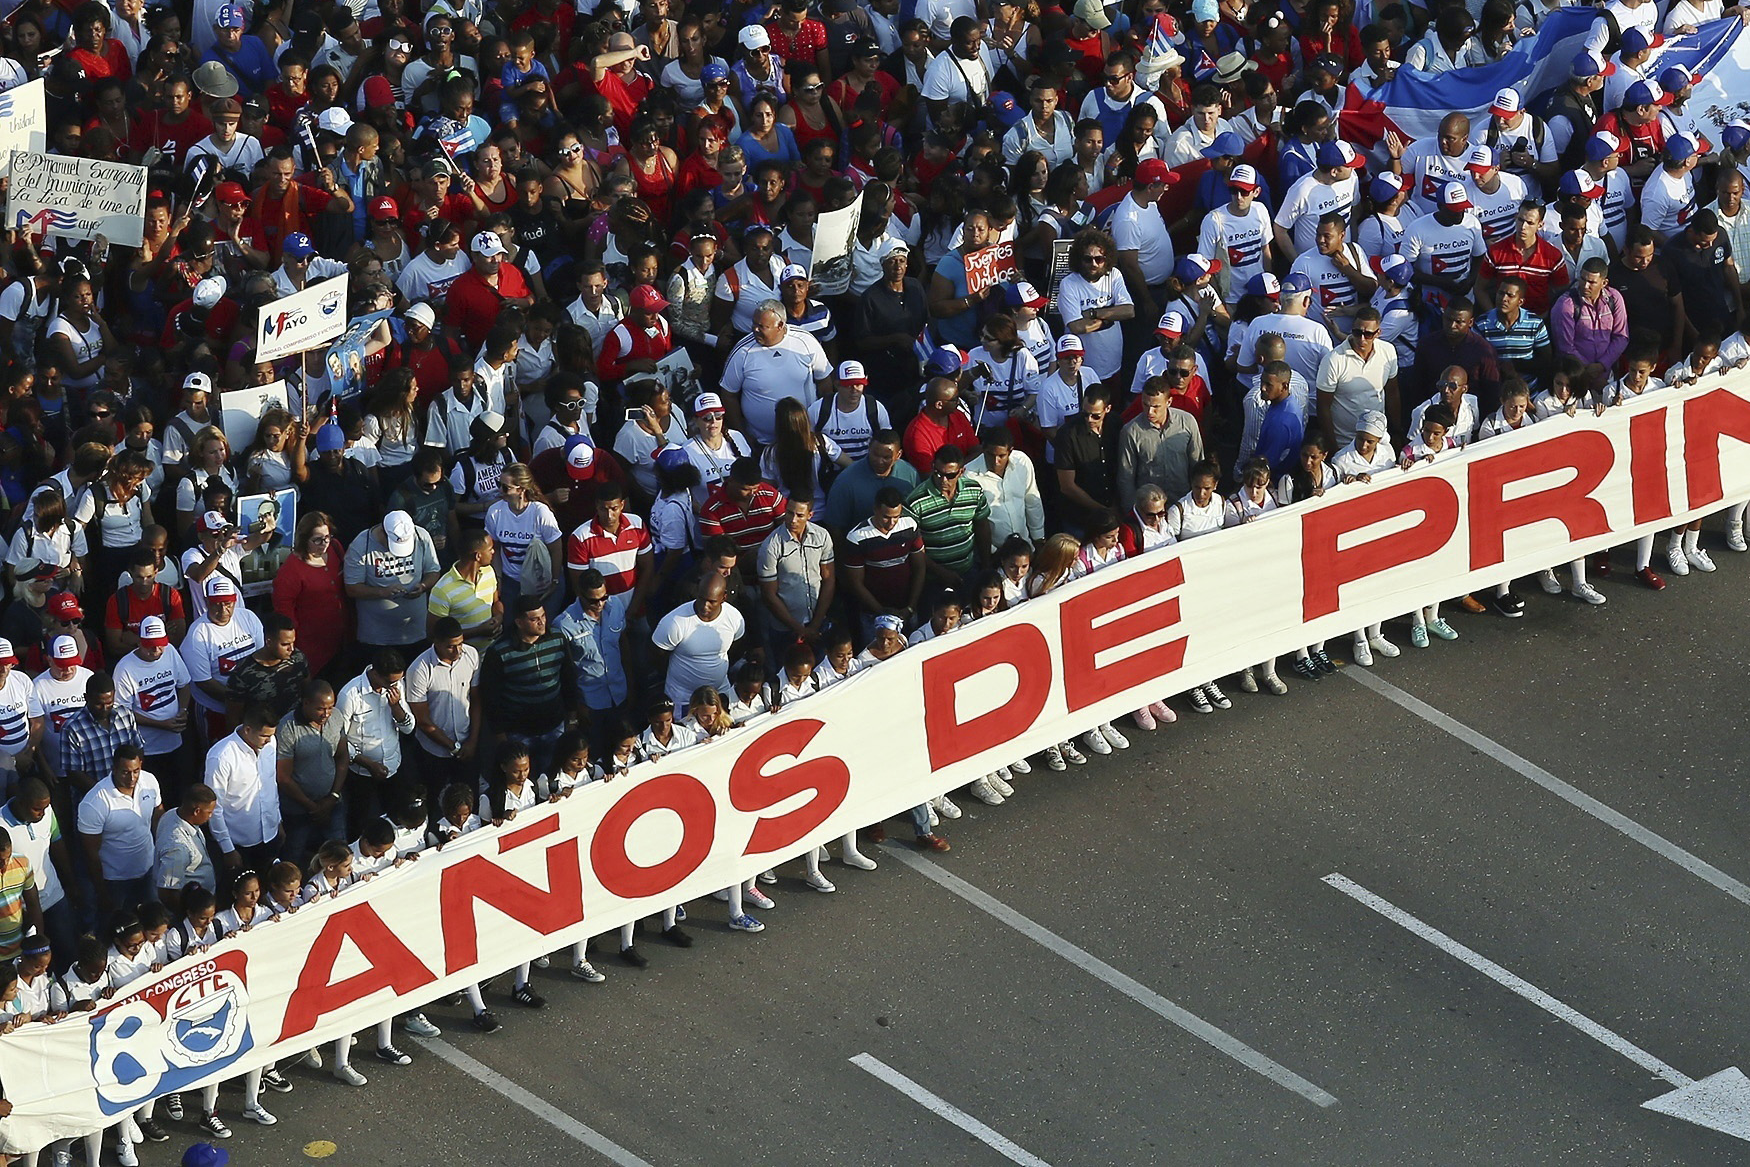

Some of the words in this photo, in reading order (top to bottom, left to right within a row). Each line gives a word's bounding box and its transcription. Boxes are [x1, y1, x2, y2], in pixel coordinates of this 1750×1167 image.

[1447, 169, 1466, 181] Cuba
[18, 173, 40, 189] del
[1335, 192, 1350, 203] Cuba
[1606, 191, 1621, 199] Cuba
[1497, 203, 1514, 214] Cuba
[1247, 228, 1260, 237] Cuba
[1452, 239, 1468, 247] Cuba
[1098, 296, 1112, 305] Cuba
[1282, 332, 1304, 340] Bloqueo
[235, 633, 252, 645] Cuba
[156, 670, 172, 681] Cuba
[70, 695, 86, 703] Cub
[6, 701, 23, 714] Cuba
[270, 718, 852, 1046] AÑOS
[922, 556, 1188, 772] DE
[145, 961, 217, 999] CONGRESO
